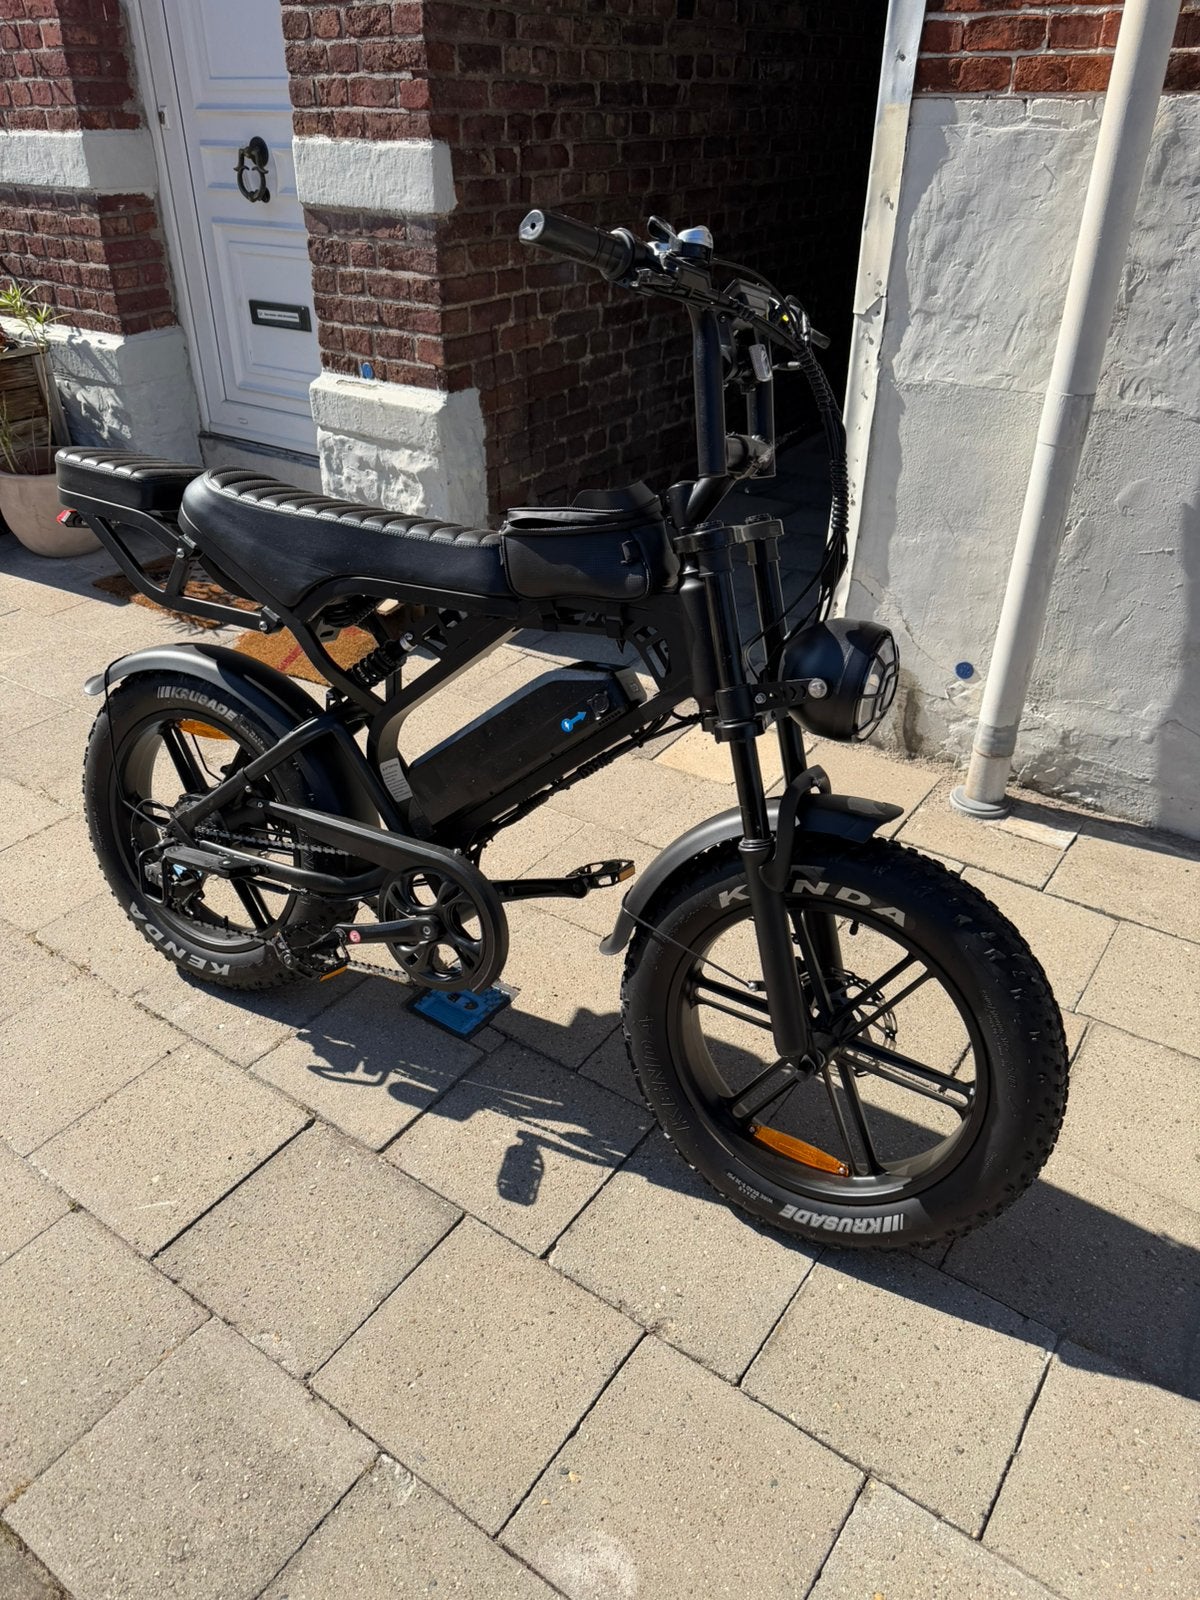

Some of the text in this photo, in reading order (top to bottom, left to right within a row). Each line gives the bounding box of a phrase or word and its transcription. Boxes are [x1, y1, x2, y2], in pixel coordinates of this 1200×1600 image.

[169, 685, 238, 722] KRUSADE
[718, 879, 906, 928] KNDA
[129, 901, 230, 976] KENDA
[778, 1203, 884, 1235] KRUSADE
